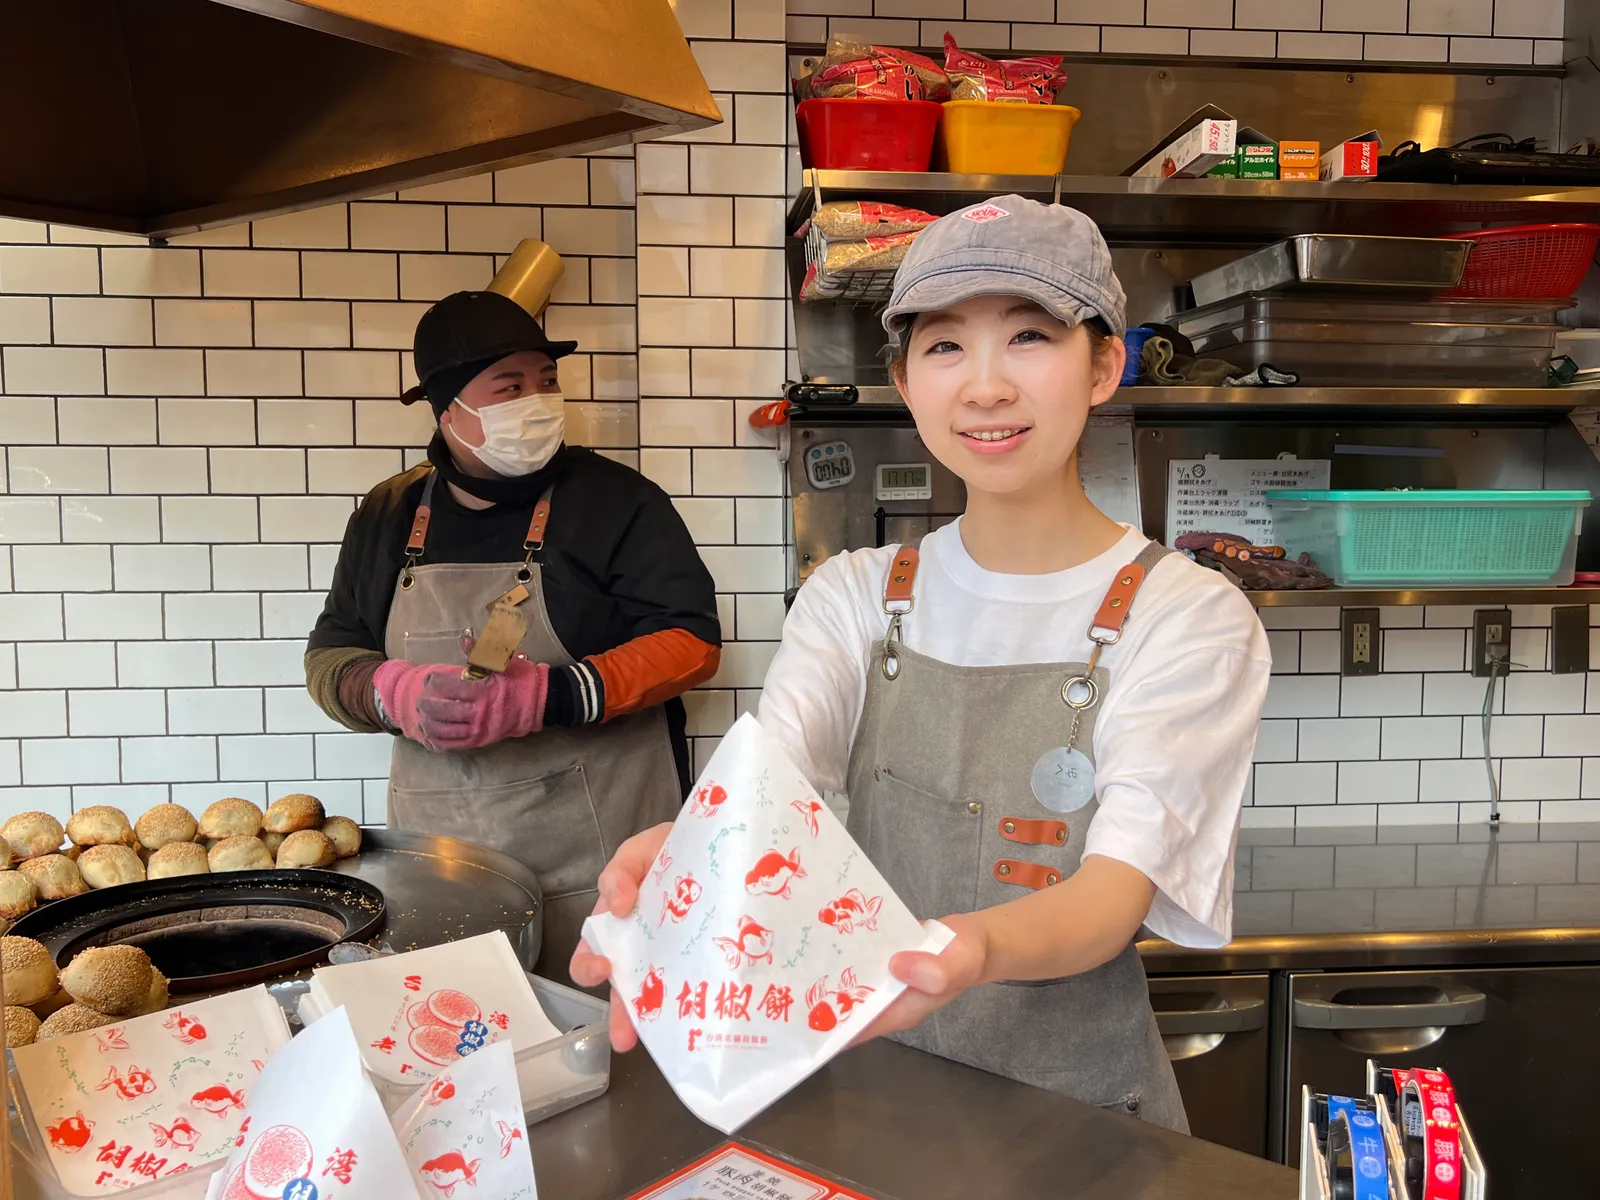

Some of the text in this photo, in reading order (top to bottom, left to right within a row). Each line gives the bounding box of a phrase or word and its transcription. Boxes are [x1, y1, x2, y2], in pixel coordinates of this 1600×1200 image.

[674, 979, 796, 1023] 胡椒餅
[1357, 1136, 1379, 1154] 牛
[1434, 1138, 1455, 1161] 豚
